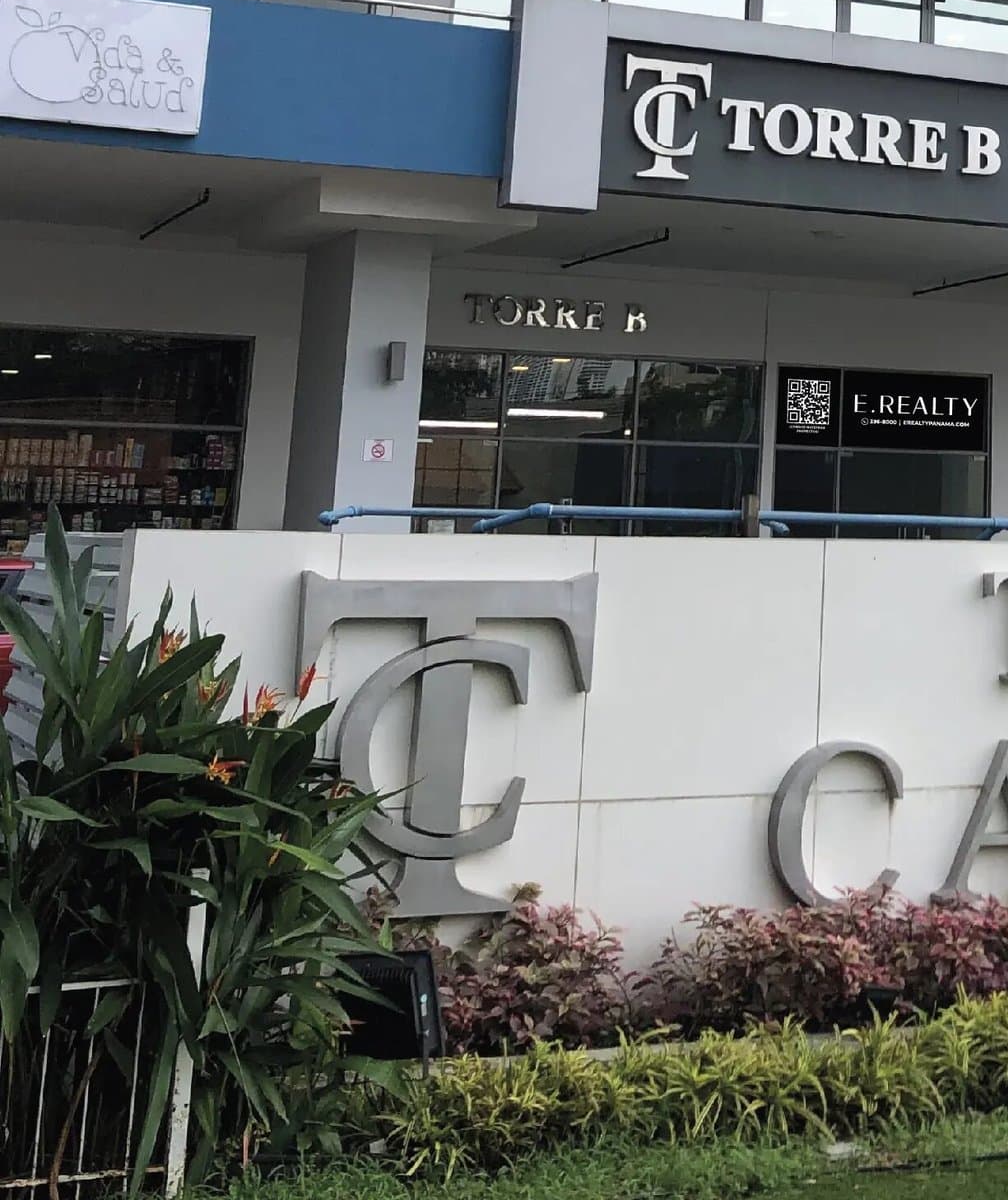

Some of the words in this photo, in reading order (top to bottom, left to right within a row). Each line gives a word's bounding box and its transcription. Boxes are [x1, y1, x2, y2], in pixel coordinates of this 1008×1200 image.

[156, 47, 184, 76] &
[720, 97, 949, 172] TORRE
[961, 124, 1002, 176] B
[464, 293, 606, 331] TORRE
[623, 302, 648, 333] B
[854, 394, 978, 417] E.REALTY
